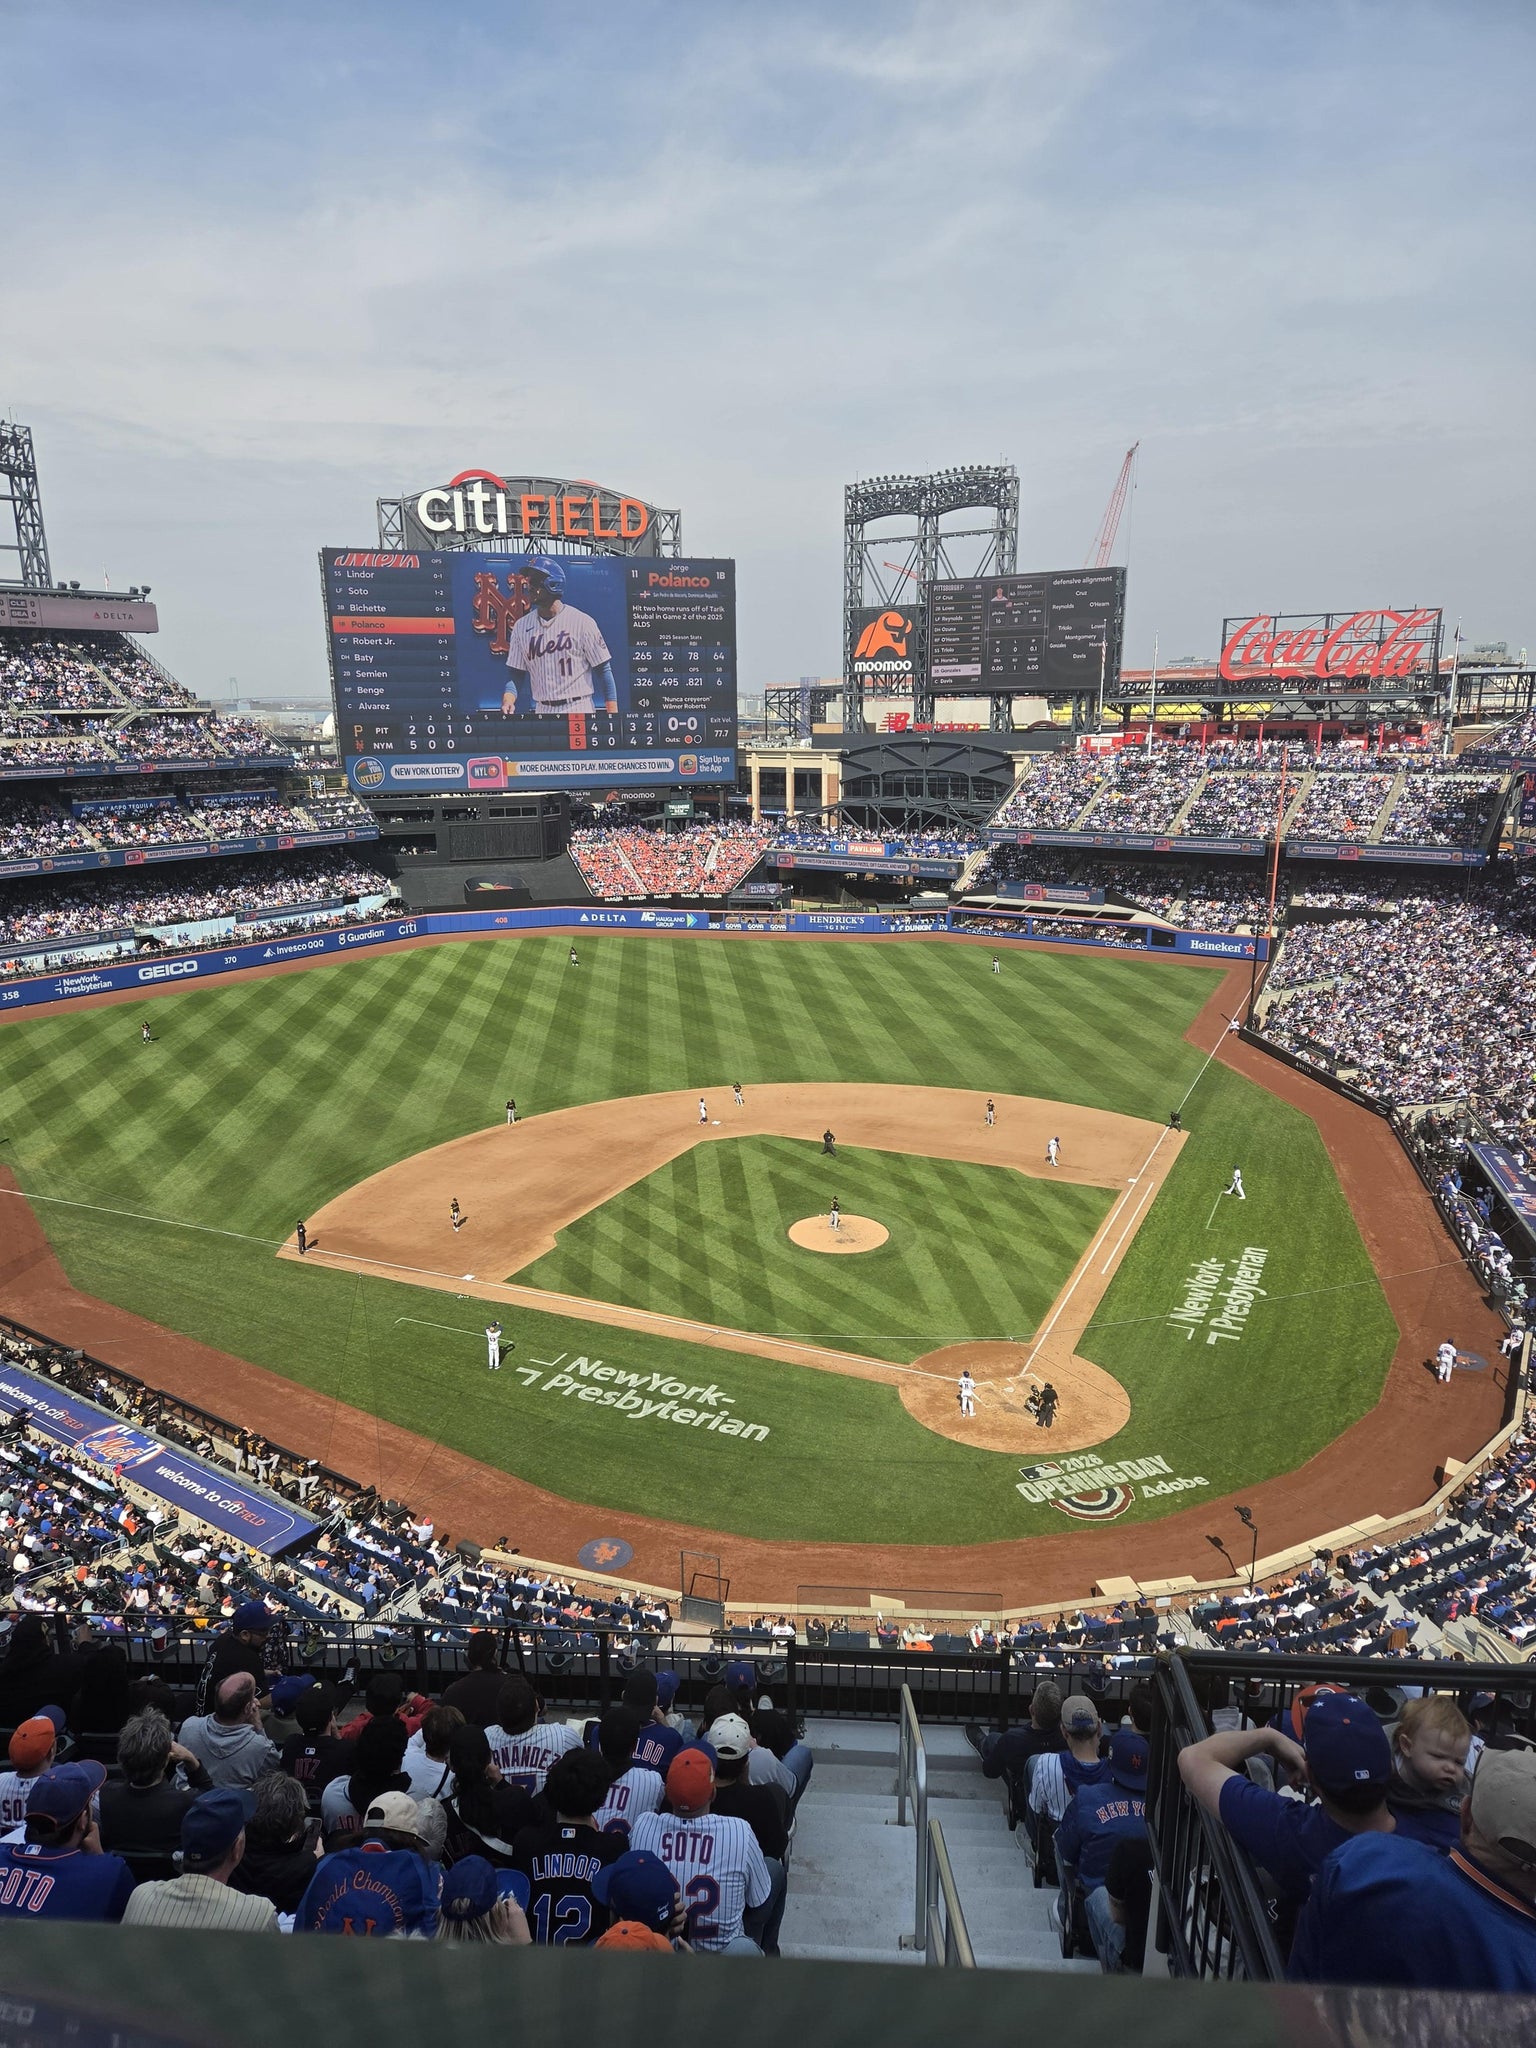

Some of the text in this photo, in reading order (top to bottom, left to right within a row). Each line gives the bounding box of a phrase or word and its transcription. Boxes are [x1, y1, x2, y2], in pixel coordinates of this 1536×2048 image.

[416, 480, 649, 538] citi FIELD
[346, 570, 374, 578] Lindor
[669, 564, 689, 572] Jorge
[632, 570, 726, 588] 11 Polanco 1B
[1053, 576, 1112, 586] defensive alignment
[348, 588, 368, 596] Soto
[350, 604, 386, 612] Bichette
[103, 612, 134, 620] DELTA
[353, 637, 382, 645] Robert
[527, 630, 572, 660] Mets
[1219, 608, 1443, 681] Coca-Cola
[354, 654, 374, 663] Baty
[632, 652, 724, 660] .265 26 78 64
[558, 658, 572, 676] 11
[854, 660, 912, 672] moomoo
[634, 678, 722, 686] .326 .495 .821 6
[358, 686, 384, 696] Benge
[409, 725, 416, 734] 2
[428, 725, 435, 734] 0
[448, 725, 452, 734] 1
[464, 724, 472, 734] 0
[574, 724, 580, 732] 3
[591, 722, 598, 732] 4
[609, 722, 613, 732] 1
[630, 722, 636, 732] 3
[646, 722, 652, 732] 2
[668, 716, 698, 730] 0-0
[936, 721, 980, 732] balance
[410, 740, 417, 750] 5
[428, 740, 436, 750] 0
[448, 740, 454, 750] 0
[576, 738, 582, 746] 5
[592, 737, 598, 746] 5
[608, 736, 616, 746] 0
[630, 736, 637, 746] 4
[646, 736, 653, 746] 2
[520, 764, 539, 772] MORE
[540, 763, 571, 772] CHANCES
[572, 763, 580, 771] TO
[598, 762, 616, 771] MORE
[618, 762, 647, 770] CHANCES
[648, 762, 656, 770] TO
[656, 761, 670, 769] WIN.
[699, 756, 712, 764] Sign
[713, 756, 721, 764] Up
[395, 766, 460, 776] NEW YORK LOTTERY
[474, 768, 488, 776] NYL
[710, 764, 722, 773] App
[621, 791, 656, 799] moomoo
[834, 844, 882, 854] citi PAVILION
[592, 914, 626, 922] DELTA
[809, 916, 864, 924] HENDRICK'S
[398, 922, 416, 934] citi
[966, 928, 1004, 938] CADILLAC
[348, 929, 385, 942] Guardian
[276, 939, 324, 955] Invesco QQQ
[1105, 942, 1148, 950] CADILLAC
[1190, 939, 1241, 953] Heineken
[224, 956, 236, 964] 370
[138, 960, 198, 981] GEICO
[63, 974, 100, 986] NewYork-
[64, 980, 112, 994] Presbyterian
[2, 990, 20, 1000] 358
[1170, 1258, 1226, 1324] NewYork-
[1209, 1247, 1269, 1331] Presbyterian
[563, 1356, 736, 1406] NewYork-
[0, 1382, 84, 1430] welcome to citi FIELD
[541, 1373, 770, 1442] Presbyterian
[1060, 1453, 1104, 1472] 2026
[1016, 1455, 1174, 1503] OPENING DAY
[1141, 1476, 1210, 1498] Adobe
[155, 1466, 266, 1526] welcome to citi FIELD
[492, 1744, 562, 1772] RNANDEZ
[632, 1737, 664, 1766] LDO
[602, 1782, 631, 1811] TO
[2, 1799, 22, 1822] SO
[1096, 1801, 1129, 1824] NEW
[662, 1832, 714, 1865] SOTO
[532, 1853, 601, 1882] LINDOR
[318, 1878, 349, 1921] World
[672, 1874, 721, 1940] 2
[533, 1894, 592, 1948] 12
